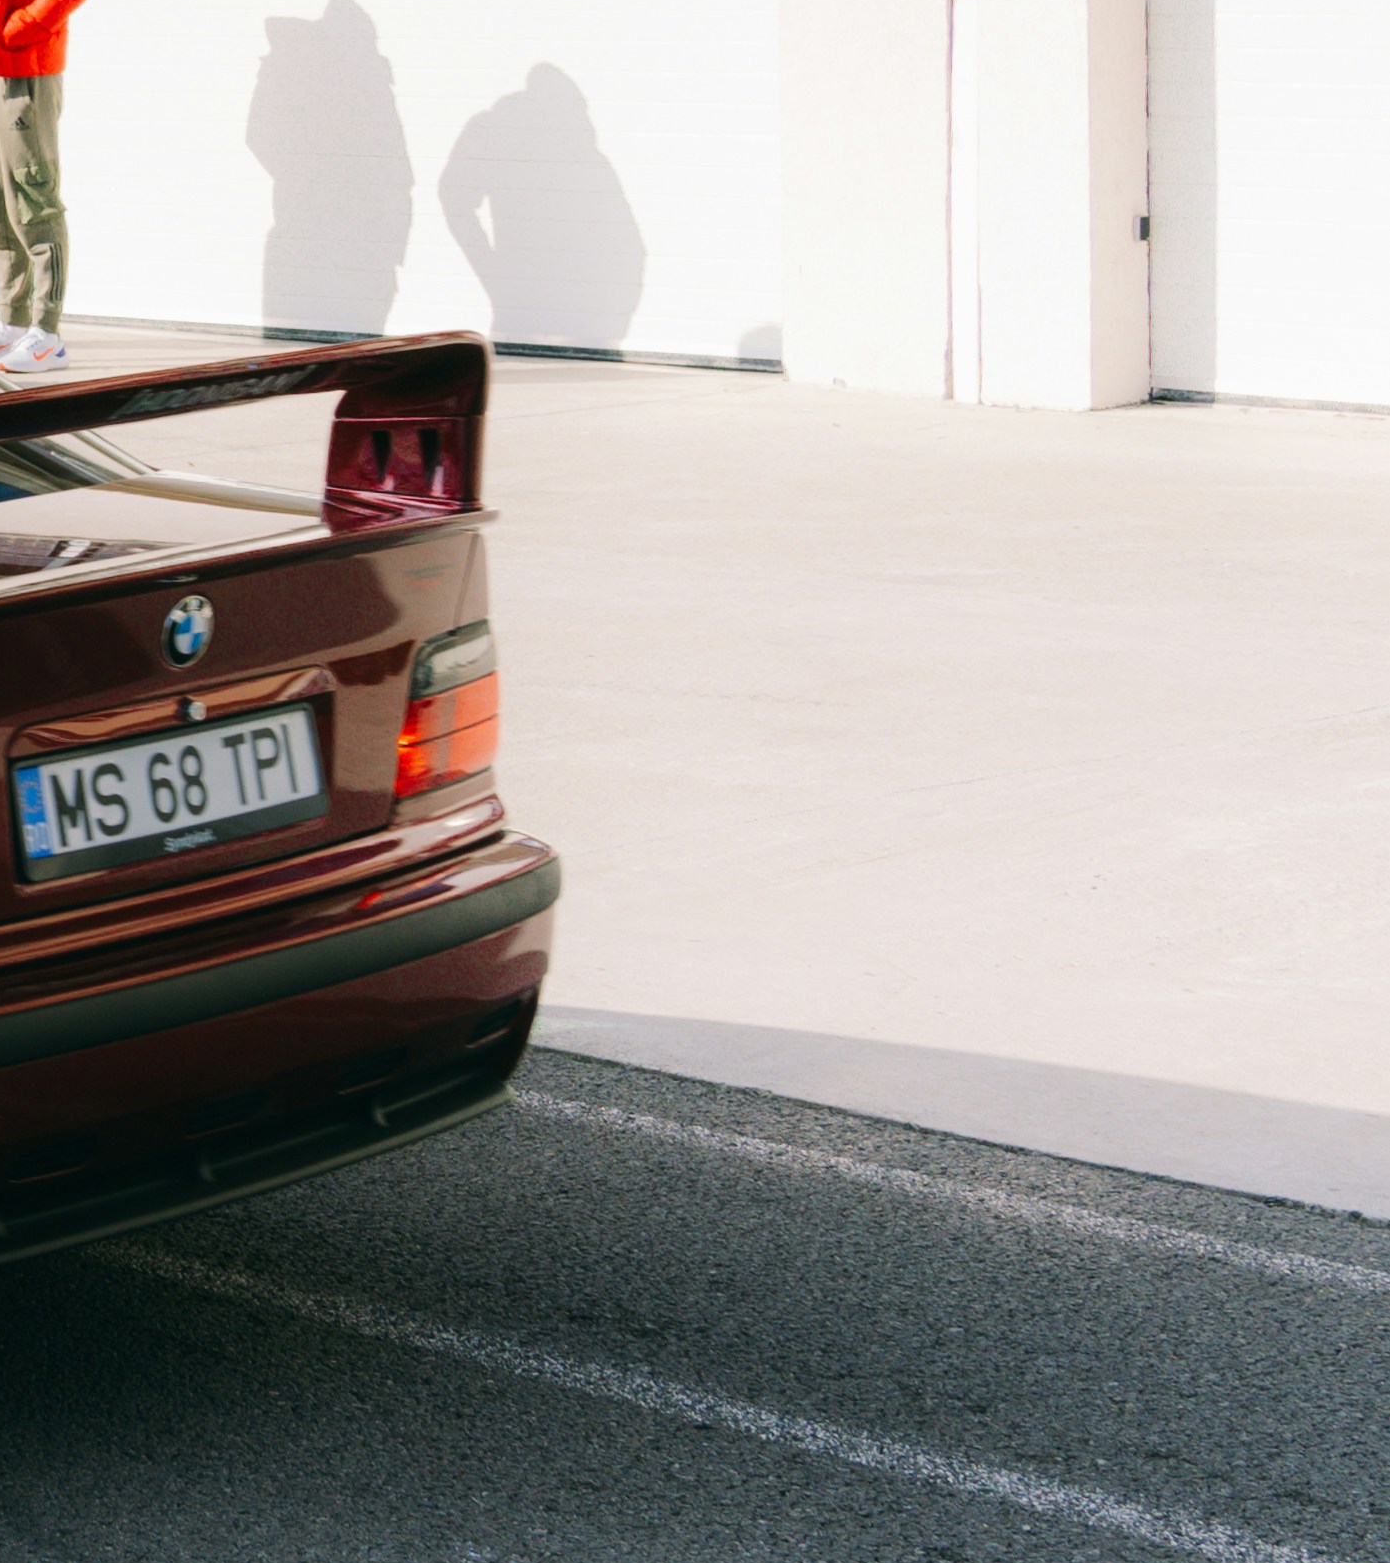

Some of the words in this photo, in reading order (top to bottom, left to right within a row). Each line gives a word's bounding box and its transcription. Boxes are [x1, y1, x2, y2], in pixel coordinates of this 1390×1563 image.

[50, 762, 129, 847] MS
[148, 744, 207, 823] 68
[222, 724, 298, 805] TPI
